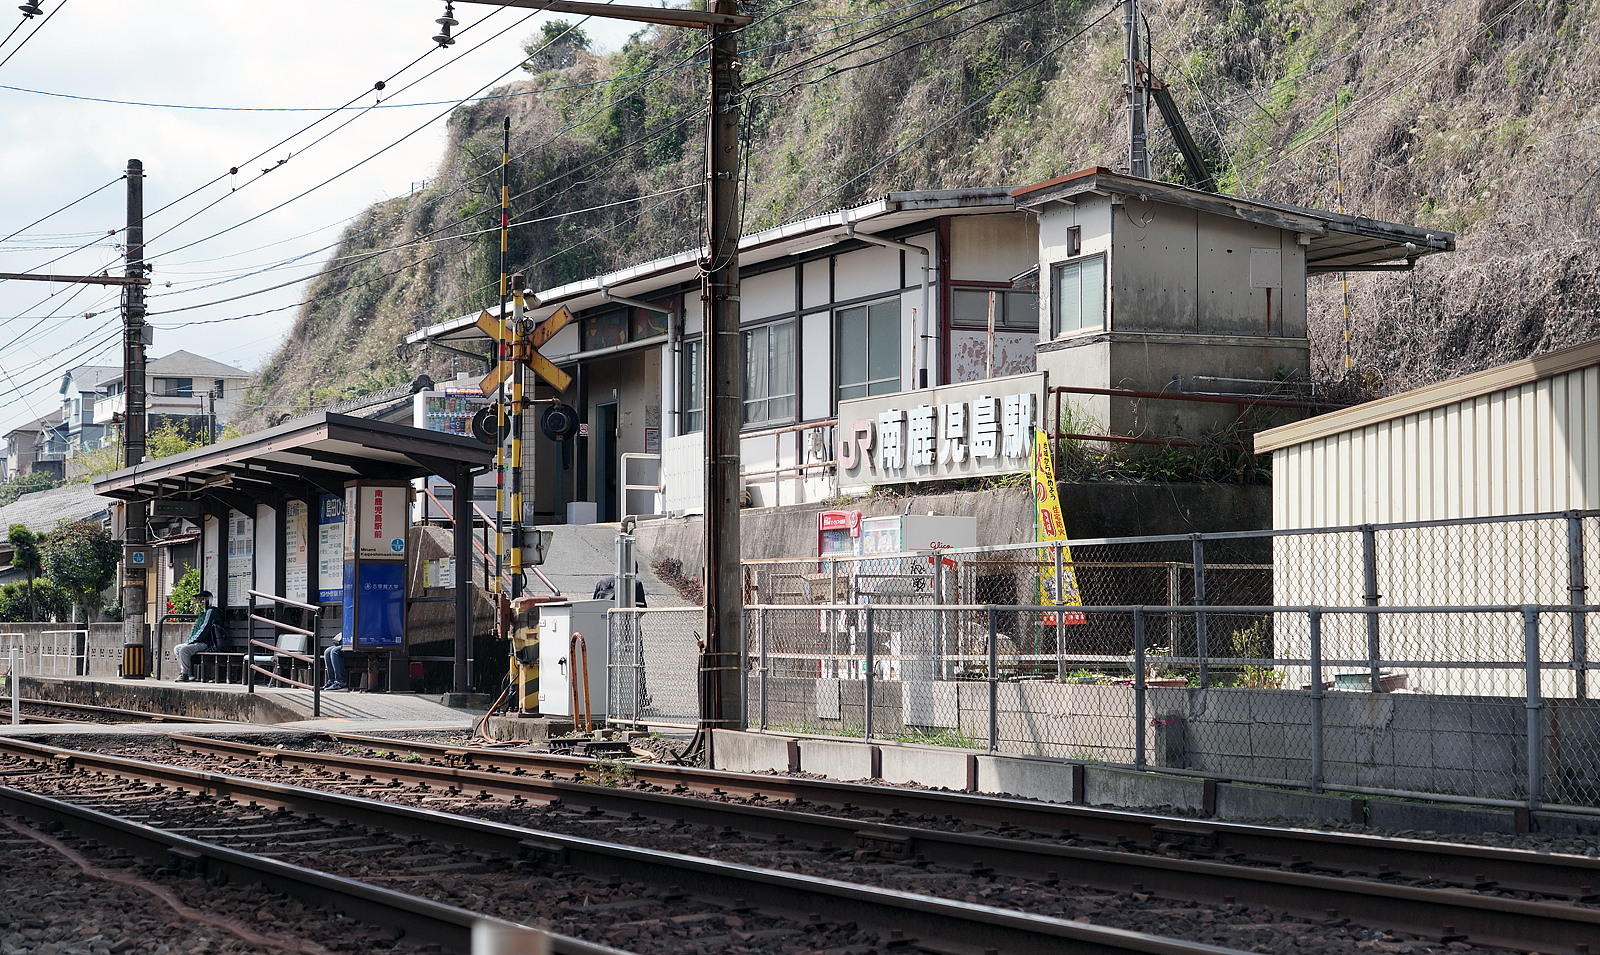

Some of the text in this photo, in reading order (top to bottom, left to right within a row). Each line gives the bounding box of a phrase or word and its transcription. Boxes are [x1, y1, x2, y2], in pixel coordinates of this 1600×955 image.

[374, 490, 383, 538] 南鹿児島駅前
[930, 541, 954, 551] Glico
